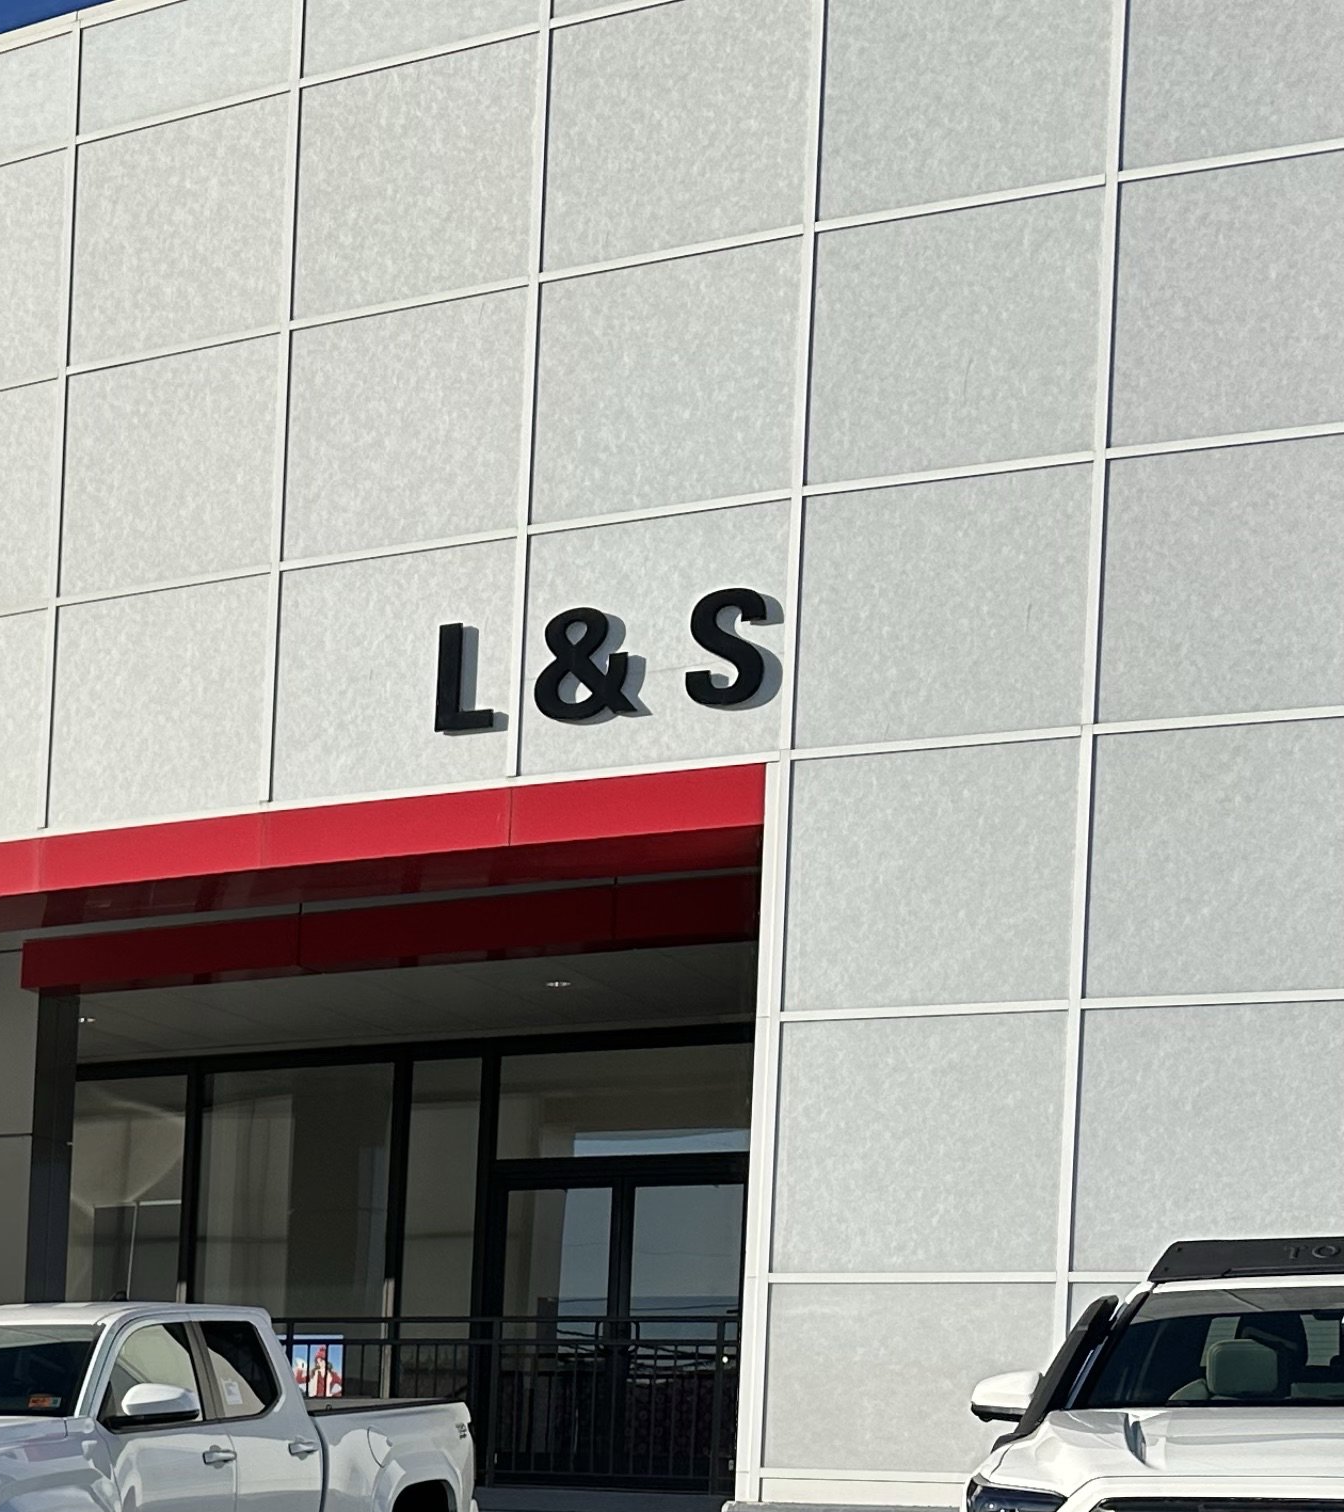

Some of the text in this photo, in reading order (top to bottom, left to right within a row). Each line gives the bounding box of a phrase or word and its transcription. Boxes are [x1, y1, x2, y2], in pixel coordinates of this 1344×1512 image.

[435, 587, 768, 732] L & S
